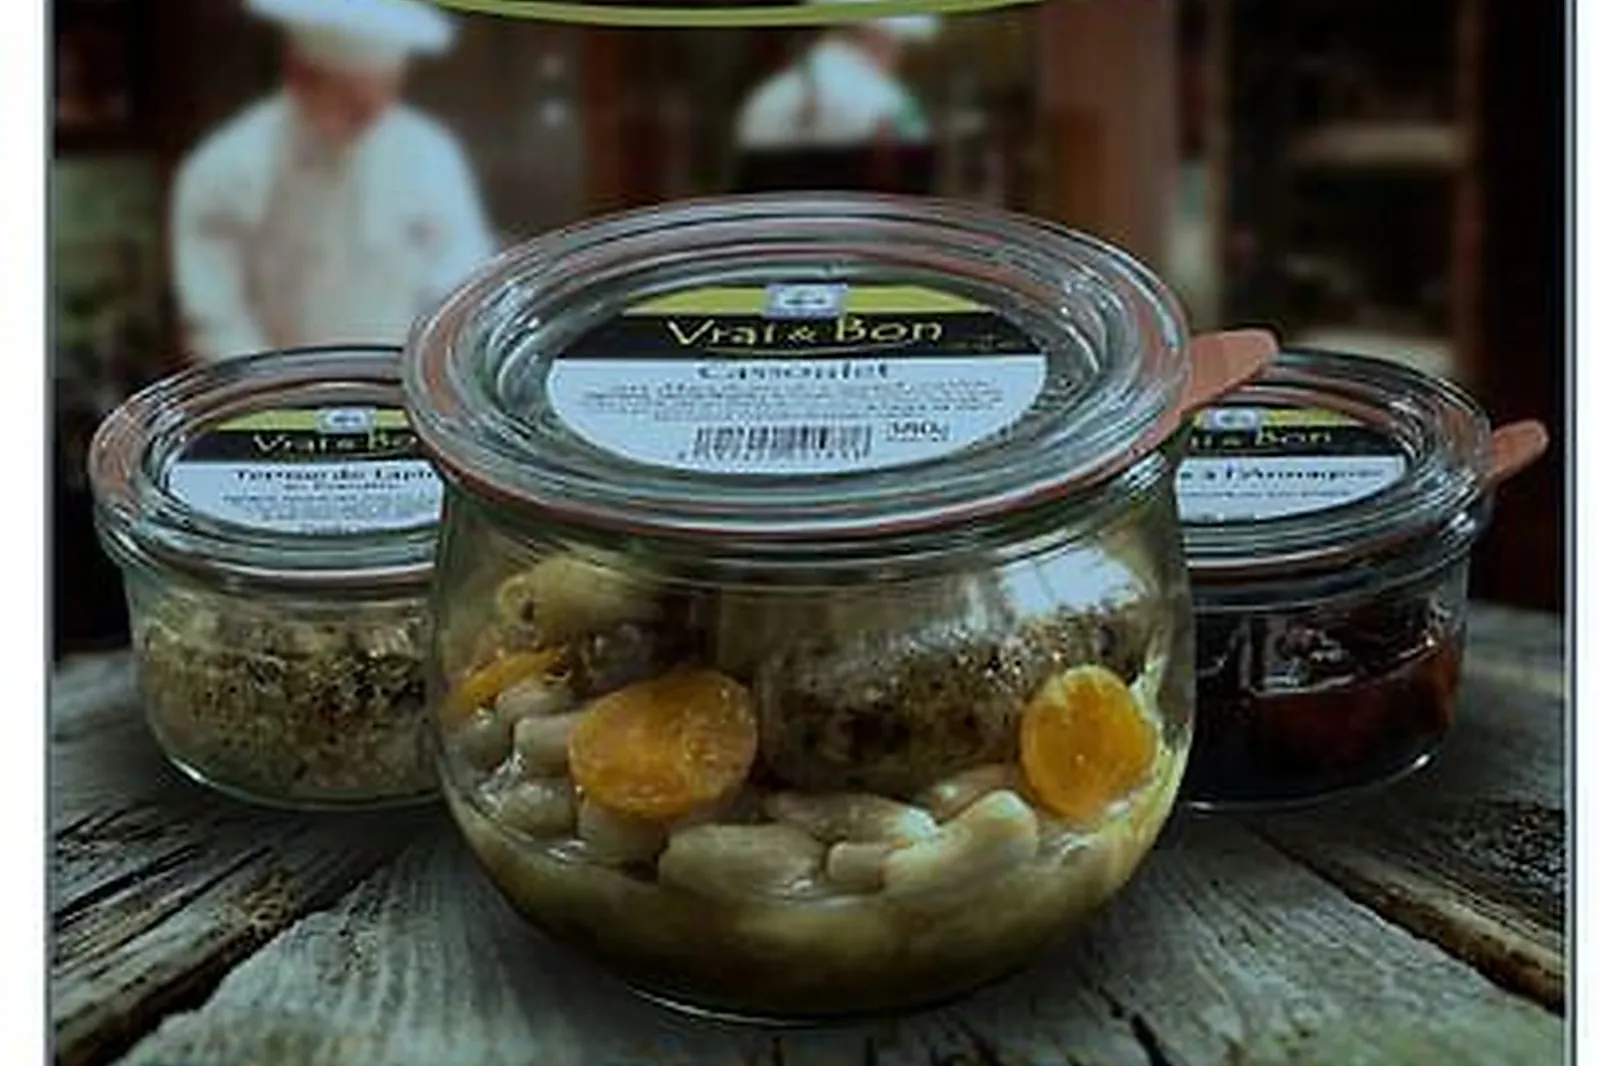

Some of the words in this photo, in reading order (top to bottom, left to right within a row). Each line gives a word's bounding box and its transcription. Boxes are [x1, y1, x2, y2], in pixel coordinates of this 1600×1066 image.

[667, 317, 776, 345] Vrai
[786, 324, 817, 344] &
[835, 316, 943, 342] Bon
